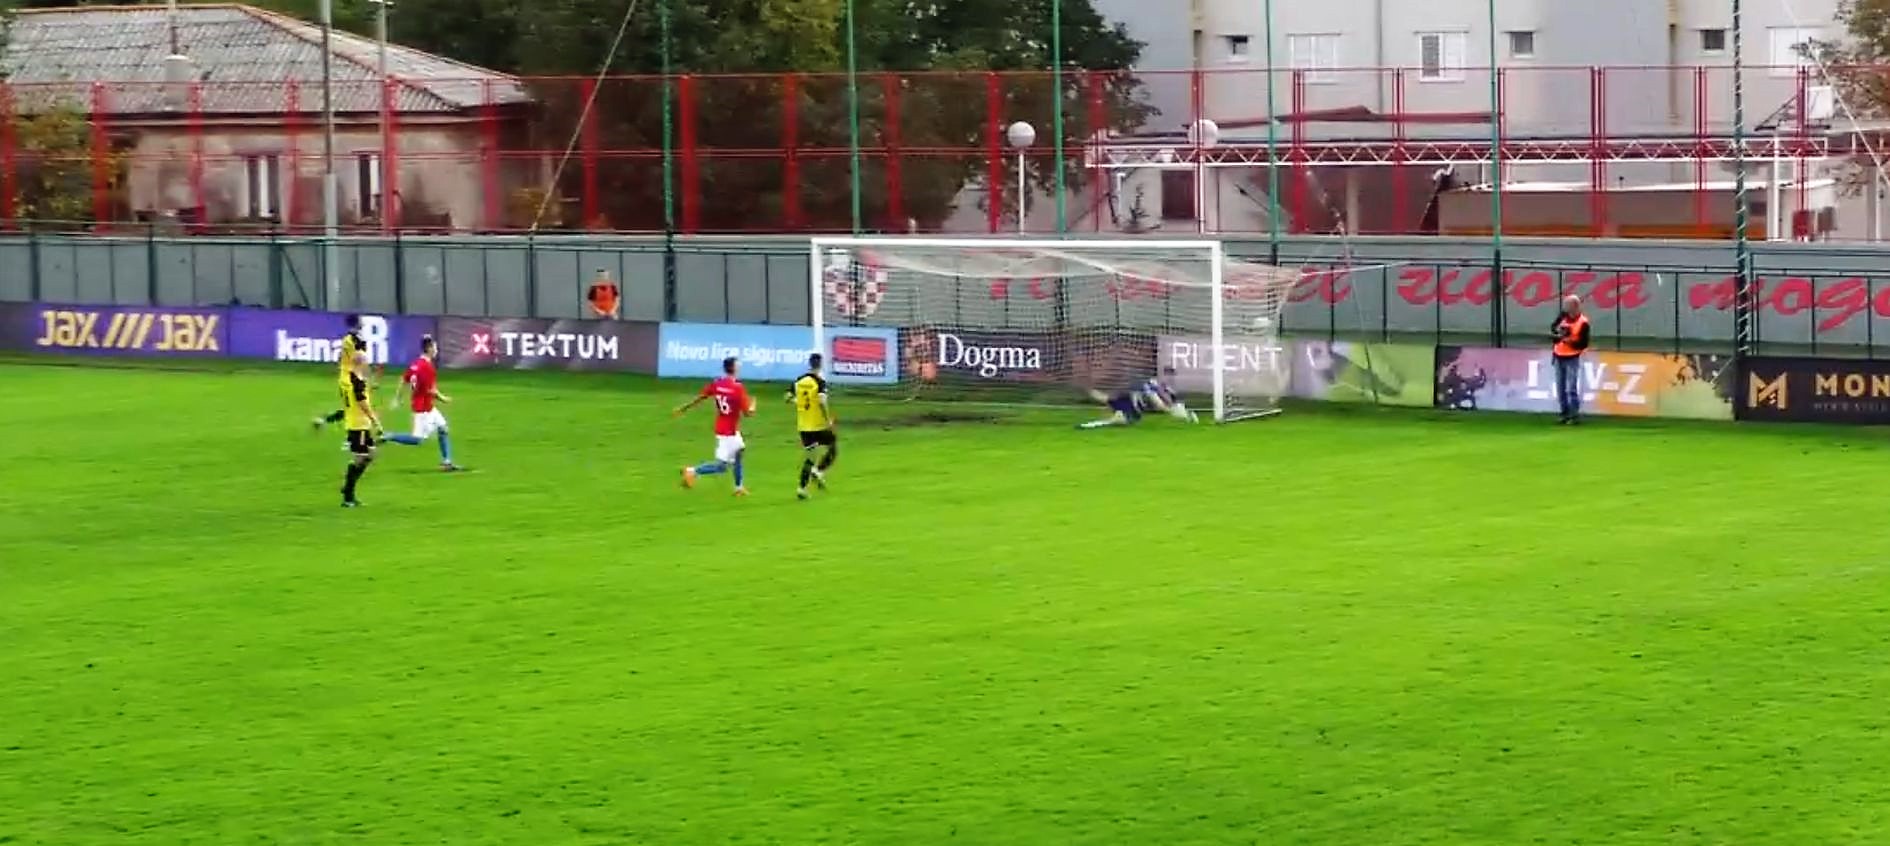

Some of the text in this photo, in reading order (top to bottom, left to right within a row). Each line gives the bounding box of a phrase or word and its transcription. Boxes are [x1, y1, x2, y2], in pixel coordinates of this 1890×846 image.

[276, 329, 343, 362] kana
[500, 332, 618, 360] TEXTUM
[937, 333, 1040, 377] Dogma
[1527, 359, 1648, 404] LV-Z
